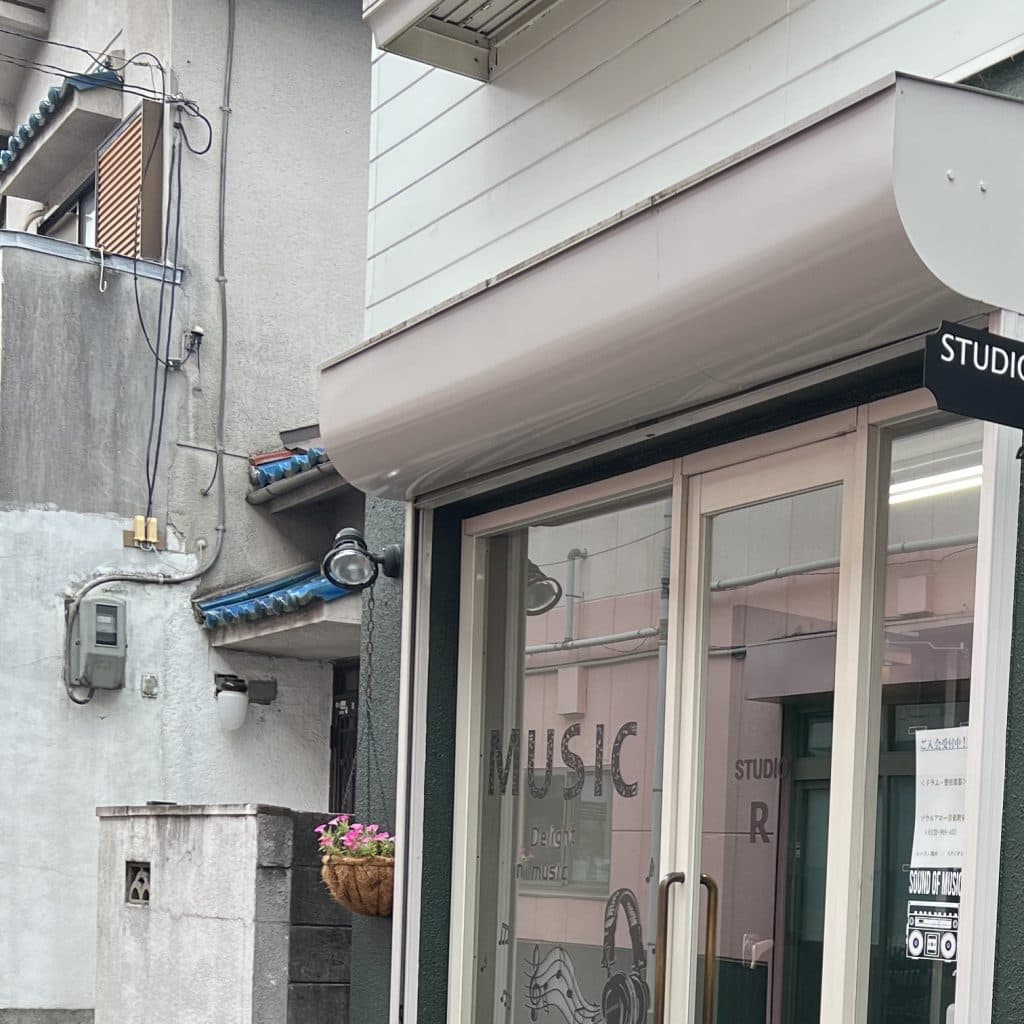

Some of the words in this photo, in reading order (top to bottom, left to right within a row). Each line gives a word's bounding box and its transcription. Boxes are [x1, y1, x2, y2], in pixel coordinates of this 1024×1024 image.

[487, 721, 638, 800] MUSIC
[735, 757, 791, 780] STUDIO
[750, 801, 770, 844] R
[532, 864, 568, 881] music
[908, 869, 931, 895] SOUND
[931, 870, 941, 895] OF
